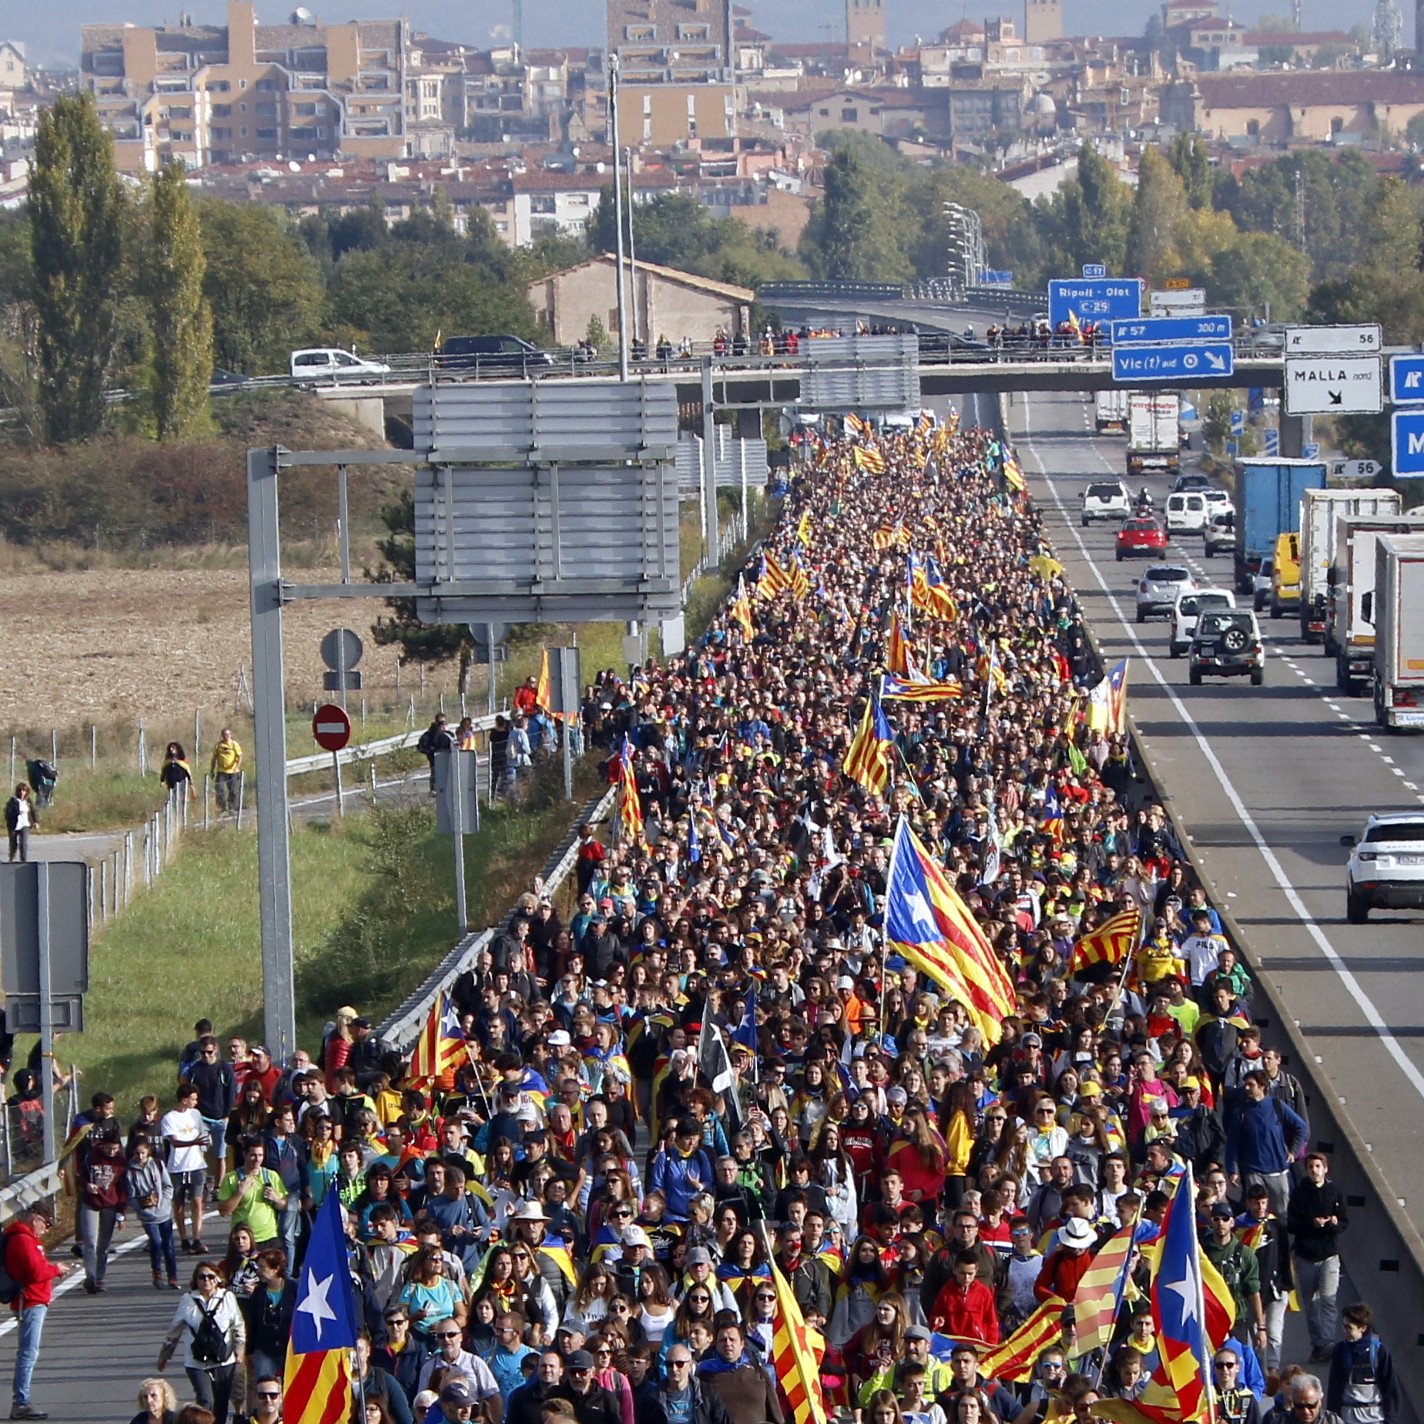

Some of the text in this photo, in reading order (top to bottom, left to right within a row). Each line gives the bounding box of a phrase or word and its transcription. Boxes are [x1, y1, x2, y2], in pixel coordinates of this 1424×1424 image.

[1130, 326, 1146, 336] 57
[1359, 334, 1373, 344] 56
[1294, 370, 1348, 382] MALLA
[1358, 464, 1374, 475] 56
